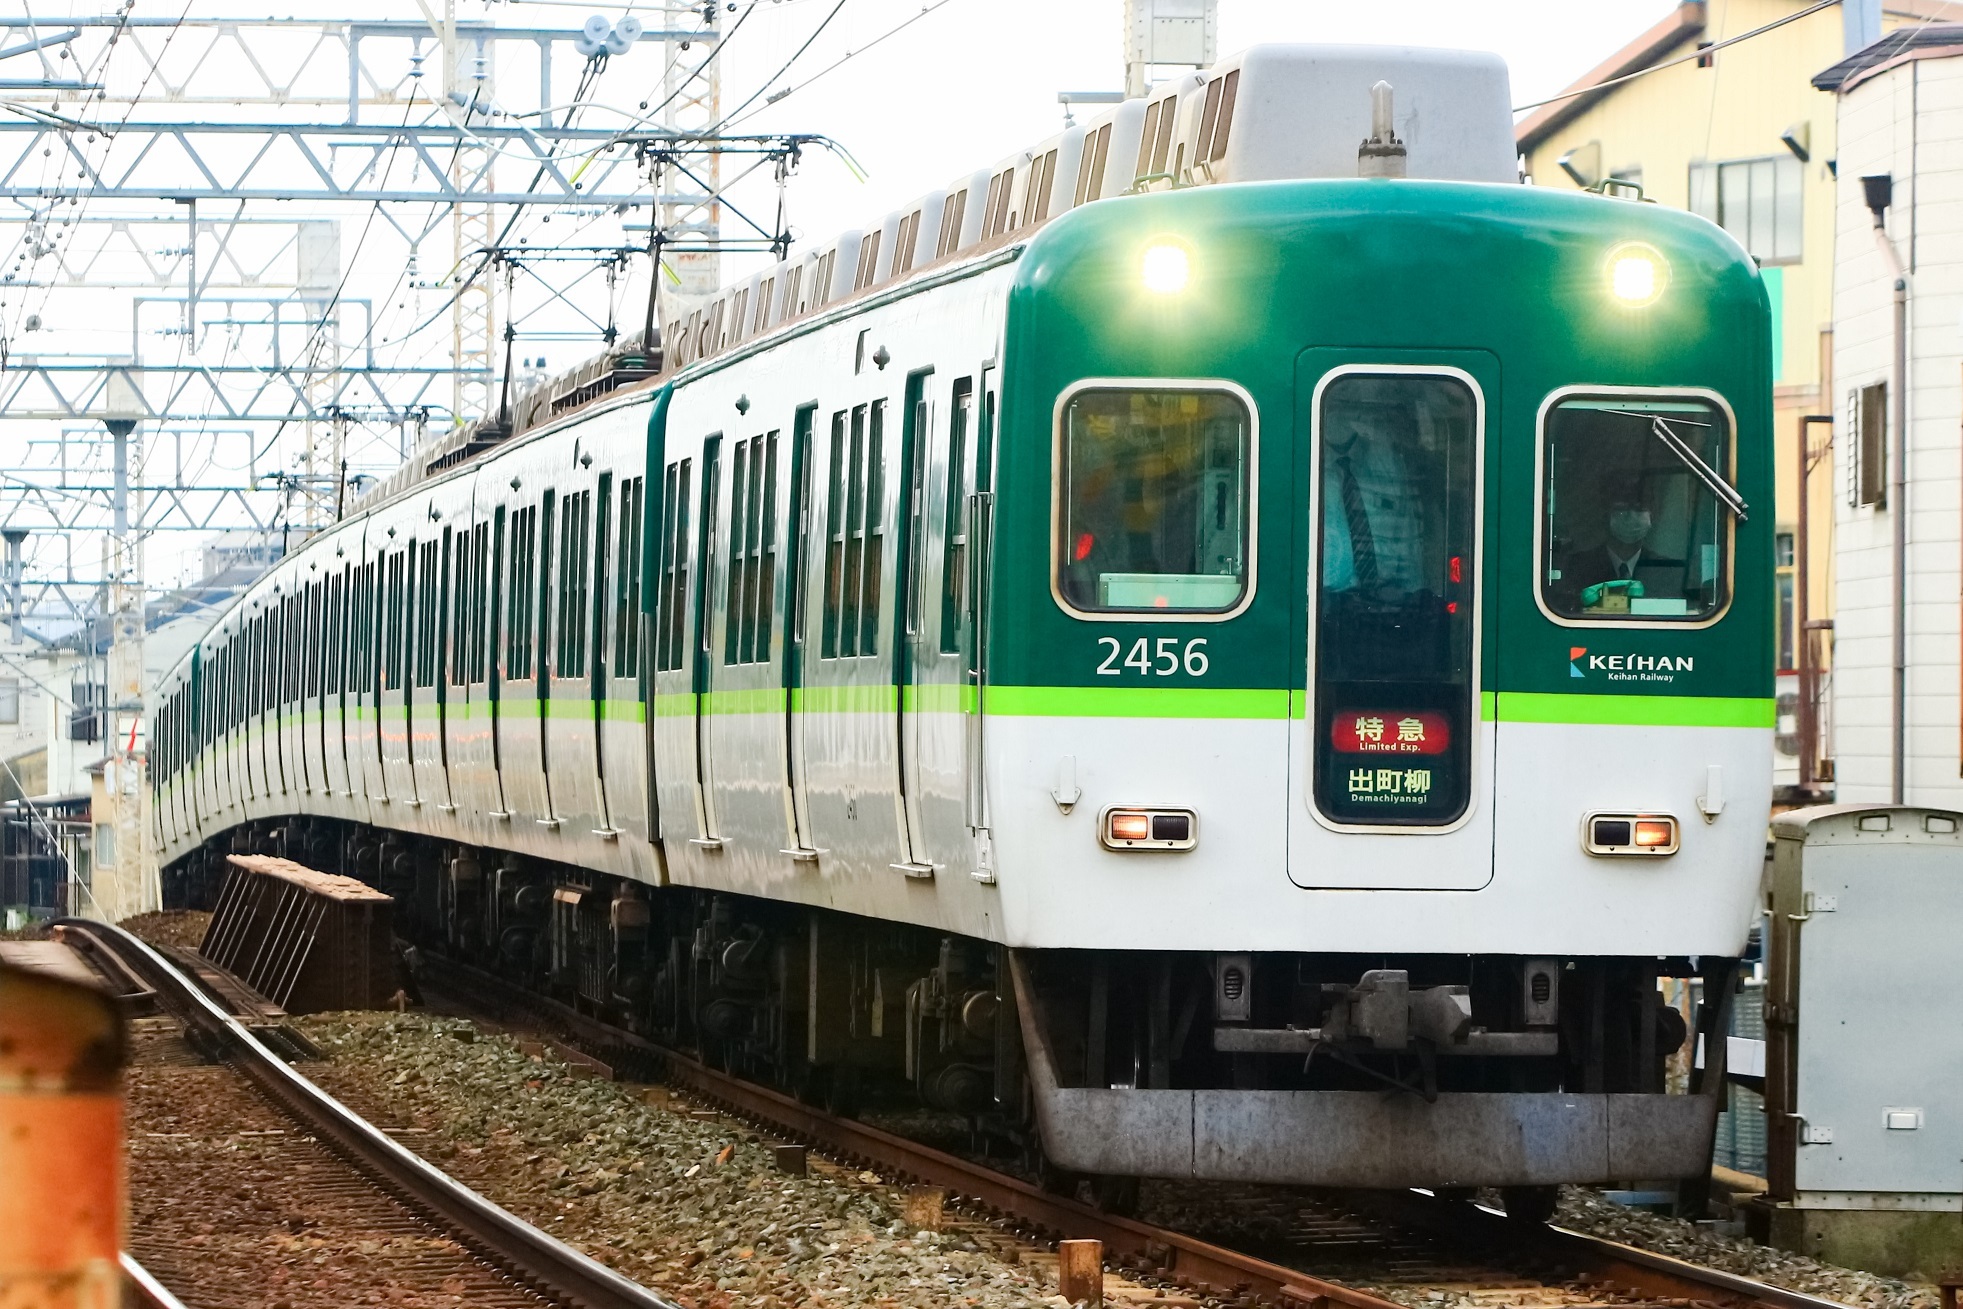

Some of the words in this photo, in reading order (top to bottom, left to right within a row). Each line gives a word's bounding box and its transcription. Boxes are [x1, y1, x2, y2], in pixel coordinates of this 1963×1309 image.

[1096, 636, 1209, 677] 2456
[1589, 653, 1694, 672] KEIHAN
[1608, 672, 1638, 681] Keihan
[1640, 673, 1674, 683] Railway
[1355, 716, 1426, 742] 特急
[1359, 742, 1397, 751] Limited
[1348, 768, 1431, 793] 出町柳
[1351, 793, 1428, 805] Demachiyanagi
